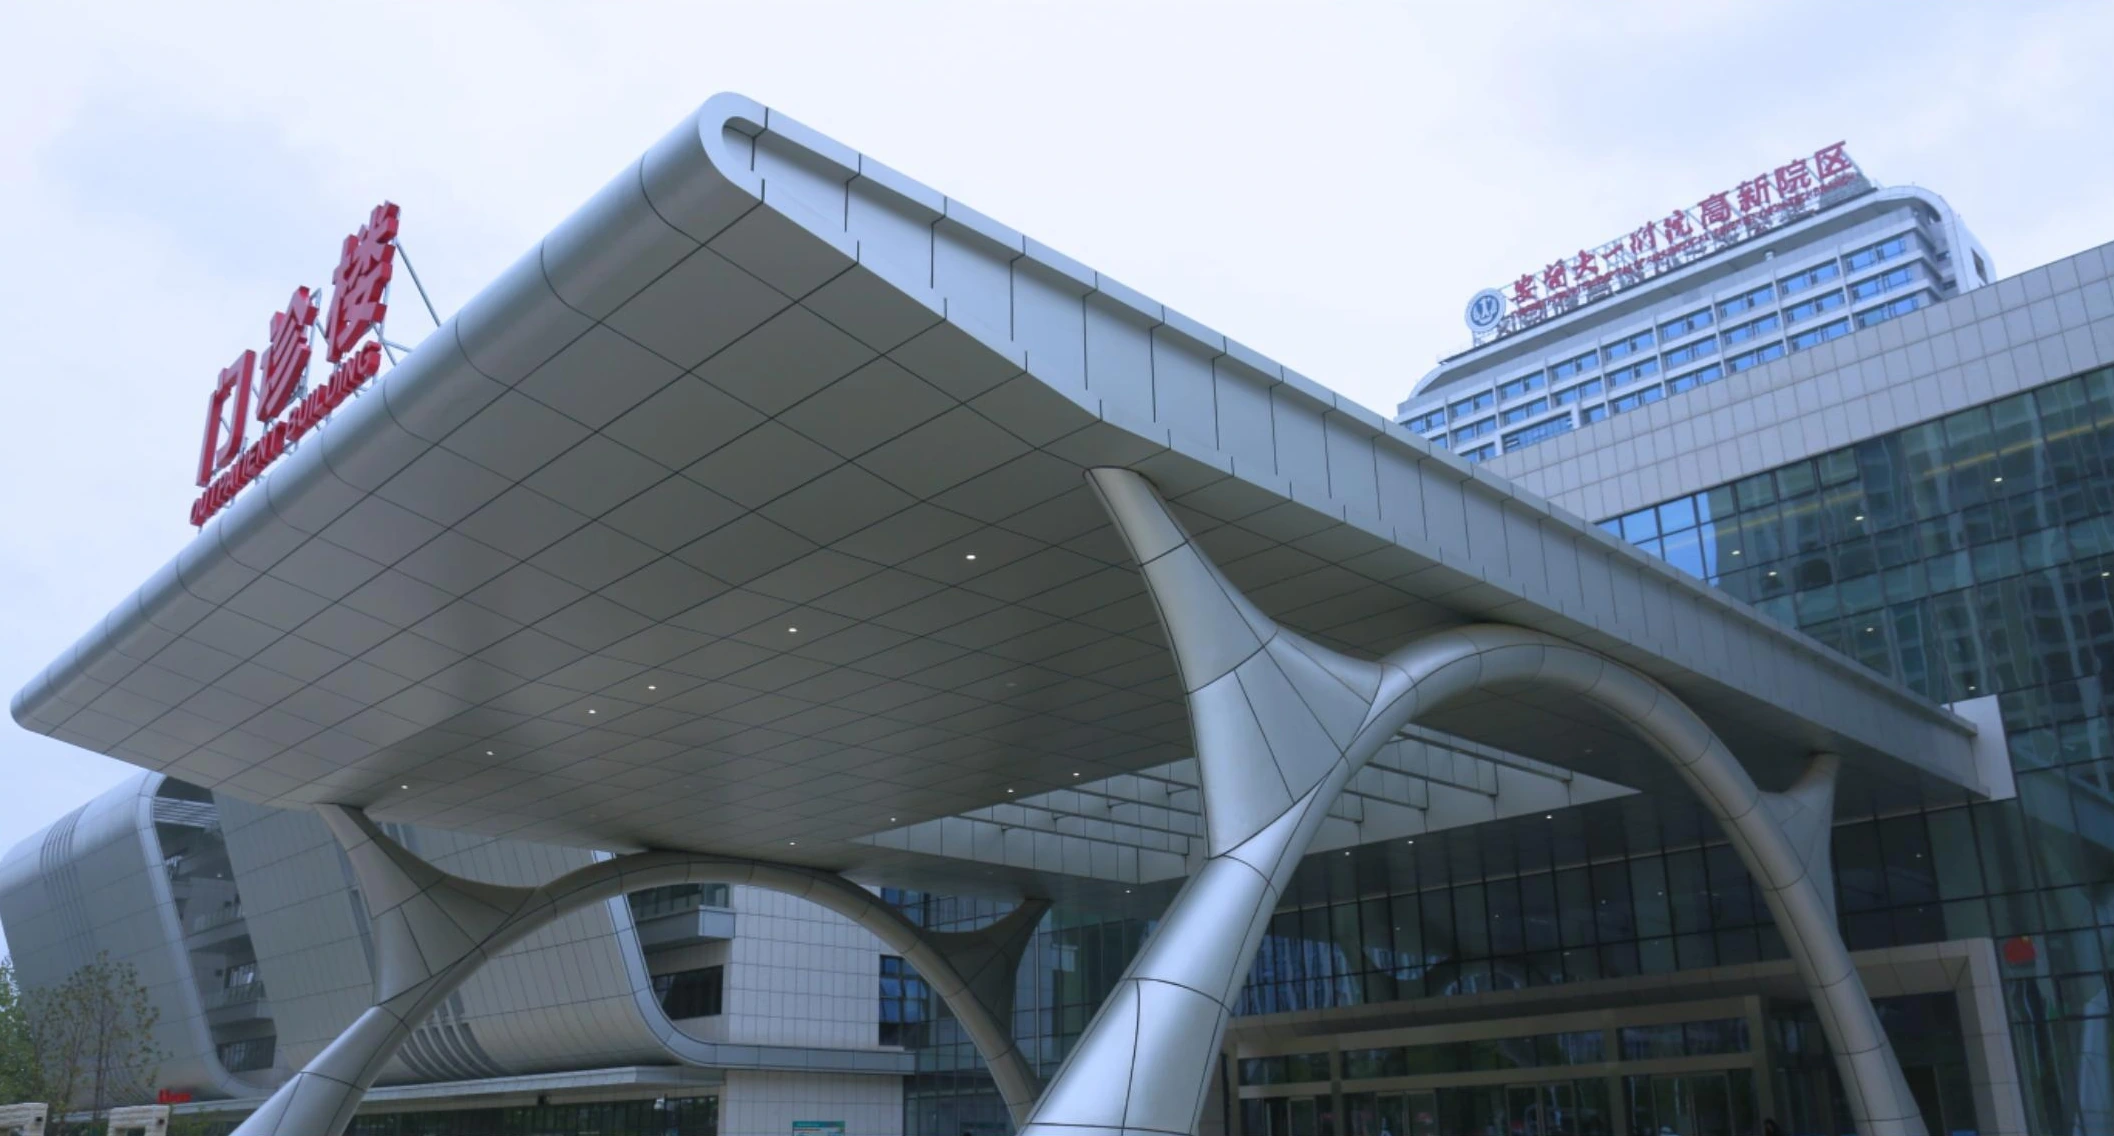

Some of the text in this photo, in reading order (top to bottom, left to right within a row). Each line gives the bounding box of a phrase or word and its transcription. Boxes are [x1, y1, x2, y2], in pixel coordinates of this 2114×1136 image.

[189, 340, 381, 526] OUTPATIENT BUILDING
[196, 200, 400, 486] 门诊楼
